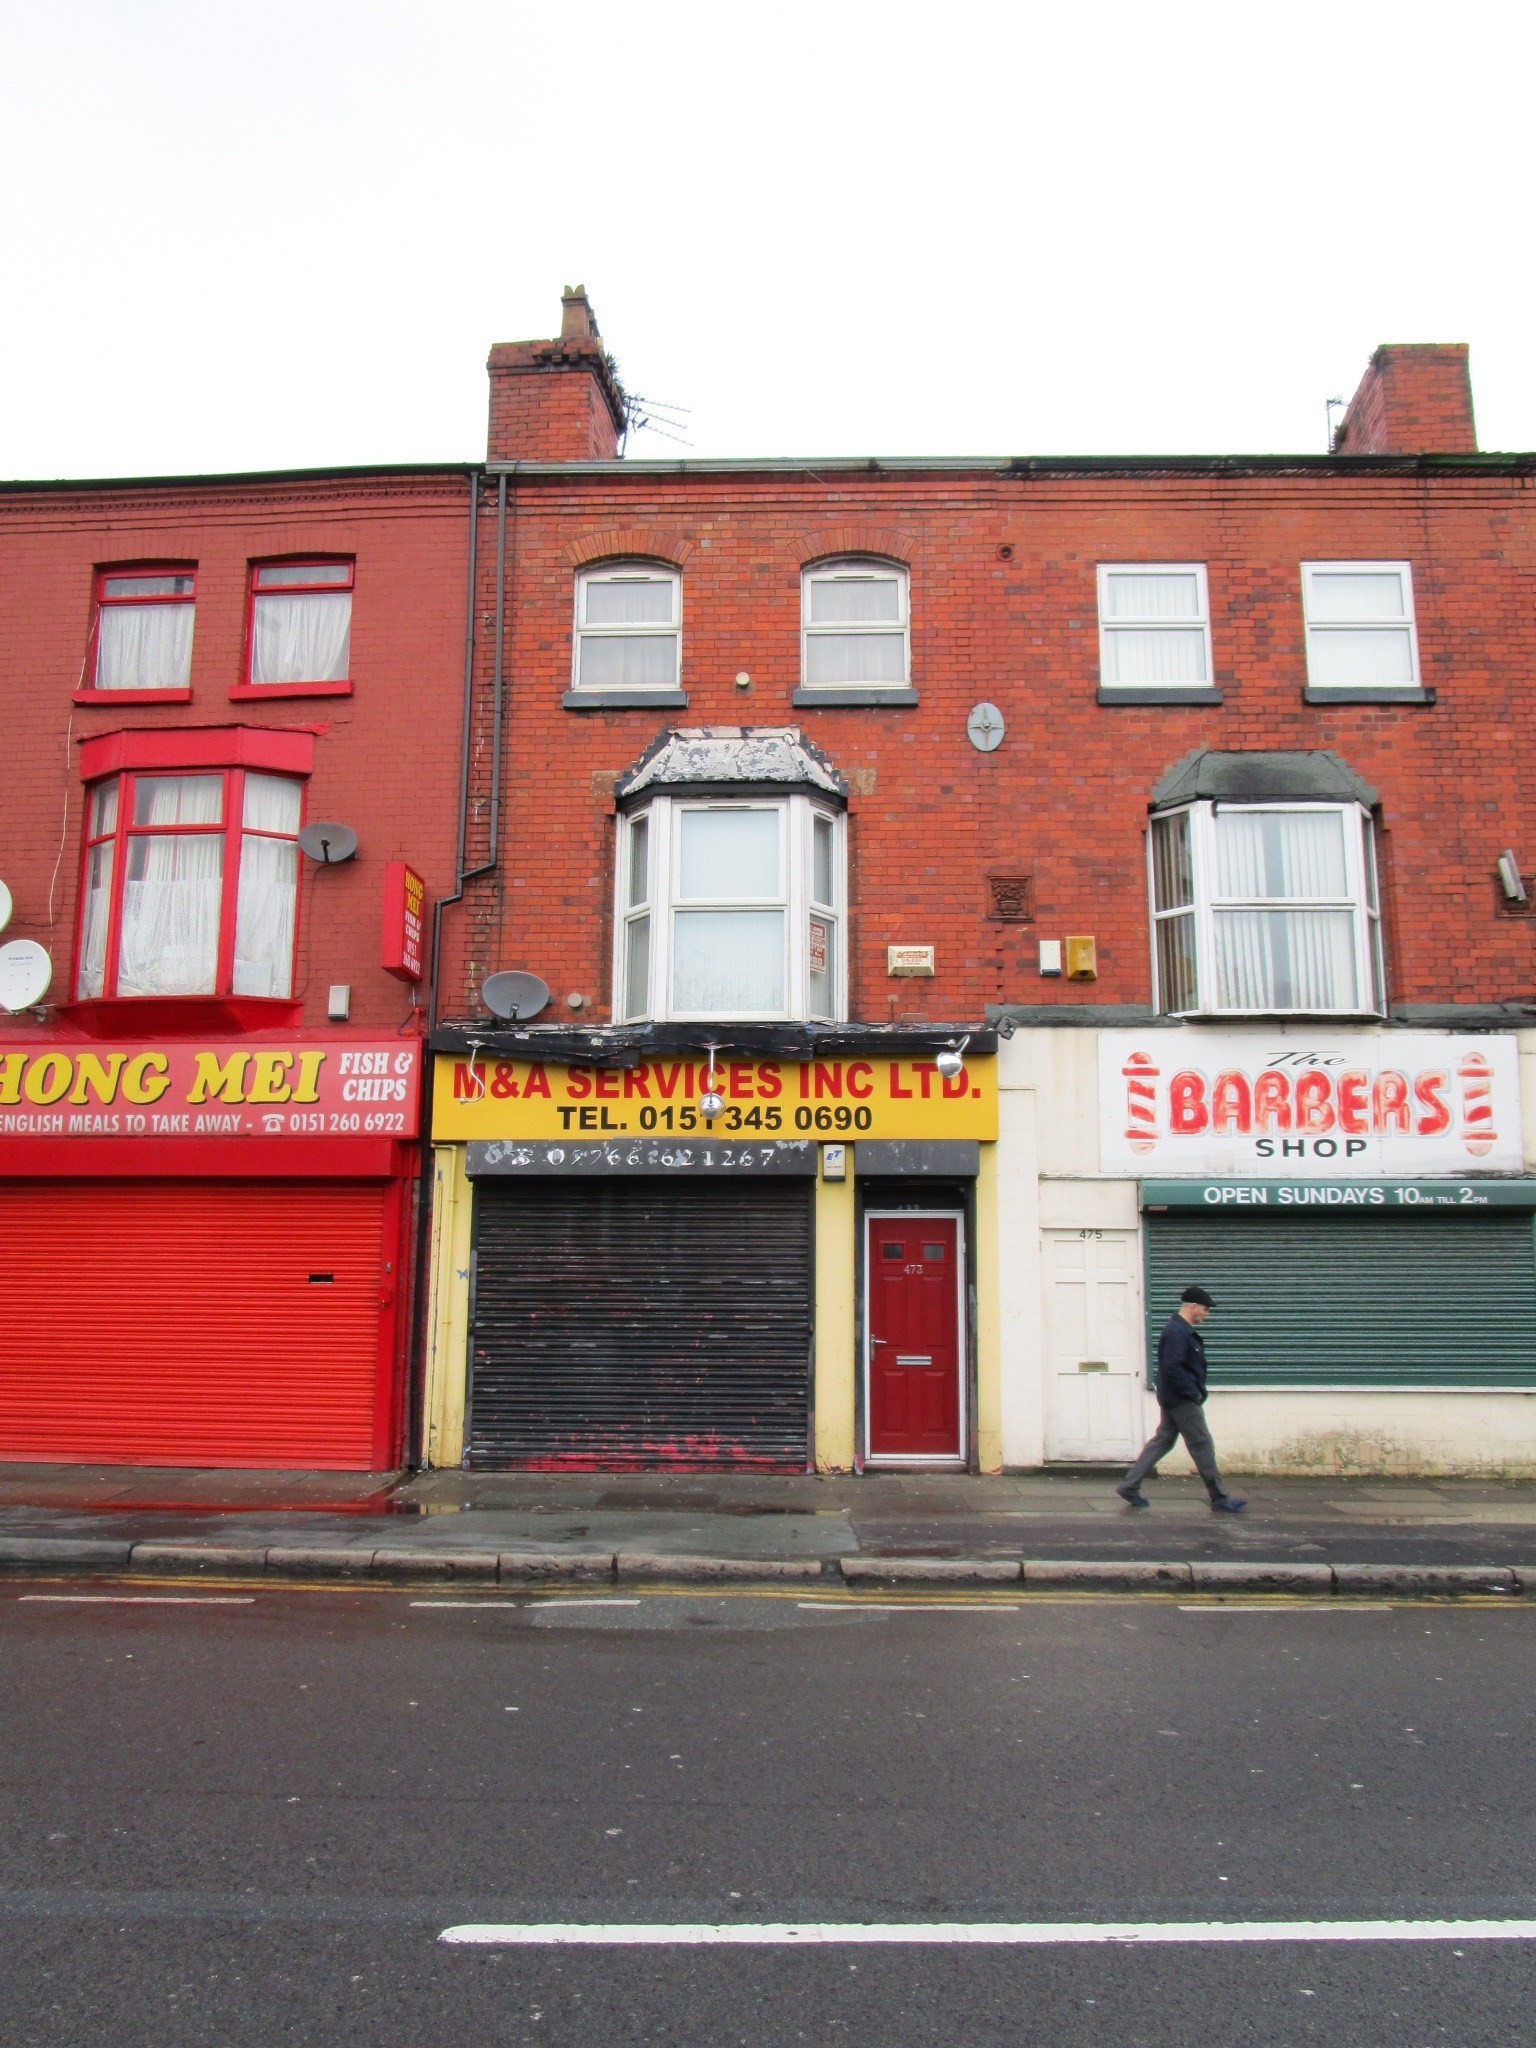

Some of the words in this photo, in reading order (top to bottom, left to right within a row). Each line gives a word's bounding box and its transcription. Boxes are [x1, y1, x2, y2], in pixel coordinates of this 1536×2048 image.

[405, 871, 424, 900] HONG
[407, 892, 420, 917] MEI
[405, 924, 420, 942] CHIPS
[339, 1053, 390, 1075] FISH
[394, 1052, 413, 1075] &
[1265, 1050, 1351, 1067] The
[0, 1052, 170, 1105] HONG
[186, 1051, 327, 1105] MEI
[343, 1078, 406, 1101] CHIPS
[453, 1063, 552, 1099] M&A
[566, 1061, 783, 1100] SERVICES
[800, 1062, 874, 1100] INC
[889, 1062, 981, 1099] LTD.
[1168, 1069, 1453, 1136] BARBERS
[68, 1114, 120, 1132] MEALS
[125, 1114, 146, 1132] TO
[152, 1114, 190, 1132] TAKE
[194, 1114, 242, 1132] AWAY
[290, 1113, 325, 1131] 0151
[329, 1113, 360, 1131] 260
[364, 1113, 405, 1131] 6922
[557, 1106, 627, 1130] TEL.
[724, 1105, 783, 1131] 345
[794, 1105, 872, 1131] 0690
[1255, 1138, 1368, 1157] SHOP
[1203, 1186, 1268, 1204] OPEN
[1277, 1186, 1385, 1204] SUNDAYS
[1394, 1187, 1433, 1204] 10AM
[1436, 1195, 1457, 1204] TILL
[1459, 1187, 1488, 1204] 2PM
[1079, 1229, 1103, 1240] 475
[903, 1263, 924, 1276] 473
